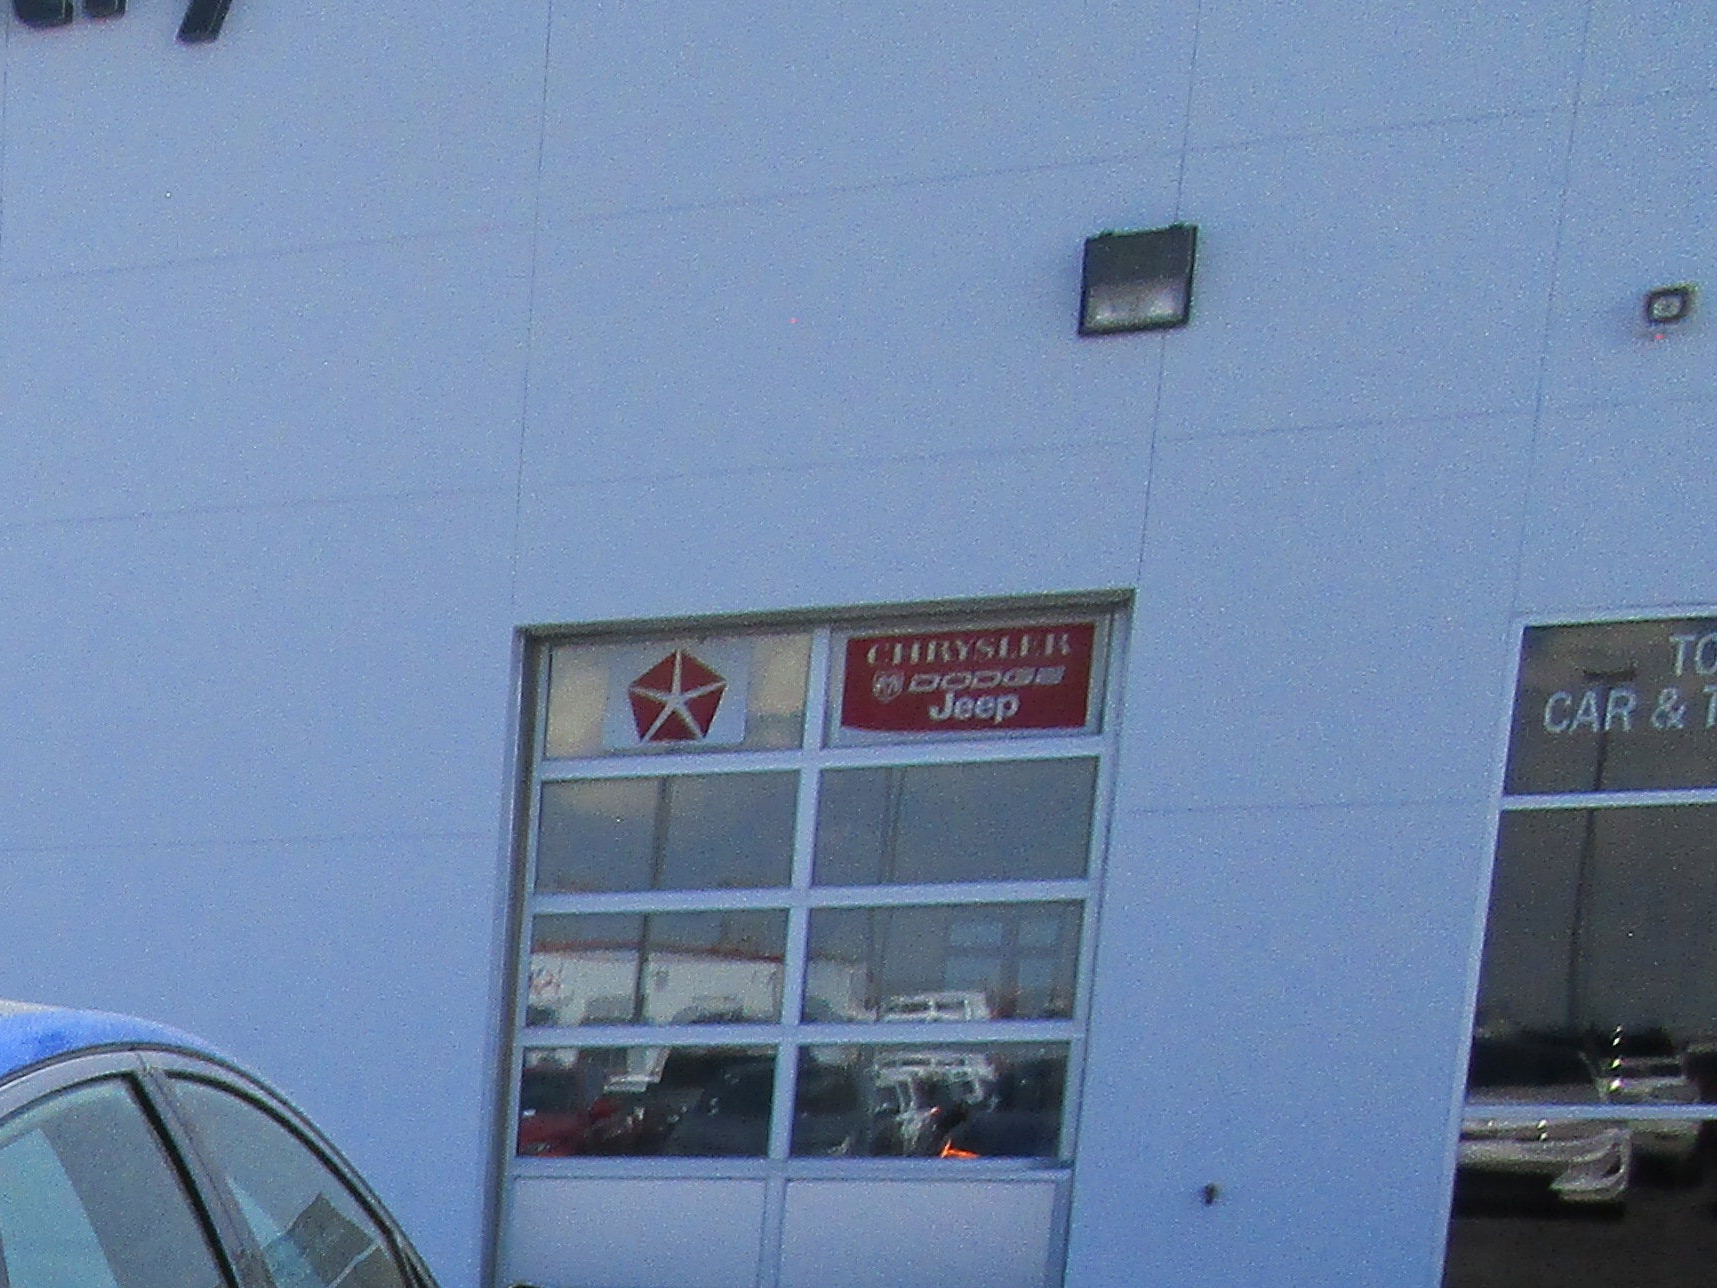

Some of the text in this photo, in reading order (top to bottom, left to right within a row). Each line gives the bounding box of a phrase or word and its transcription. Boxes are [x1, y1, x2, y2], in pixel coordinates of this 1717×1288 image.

[866, 632, 1072, 667] CHRYSLER
[907, 664, 1067, 694] DODGE
[927, 690, 1022, 725] Jeep
[1543, 688, 1638, 734] CAR
[1650, 686, 1687, 730] &
